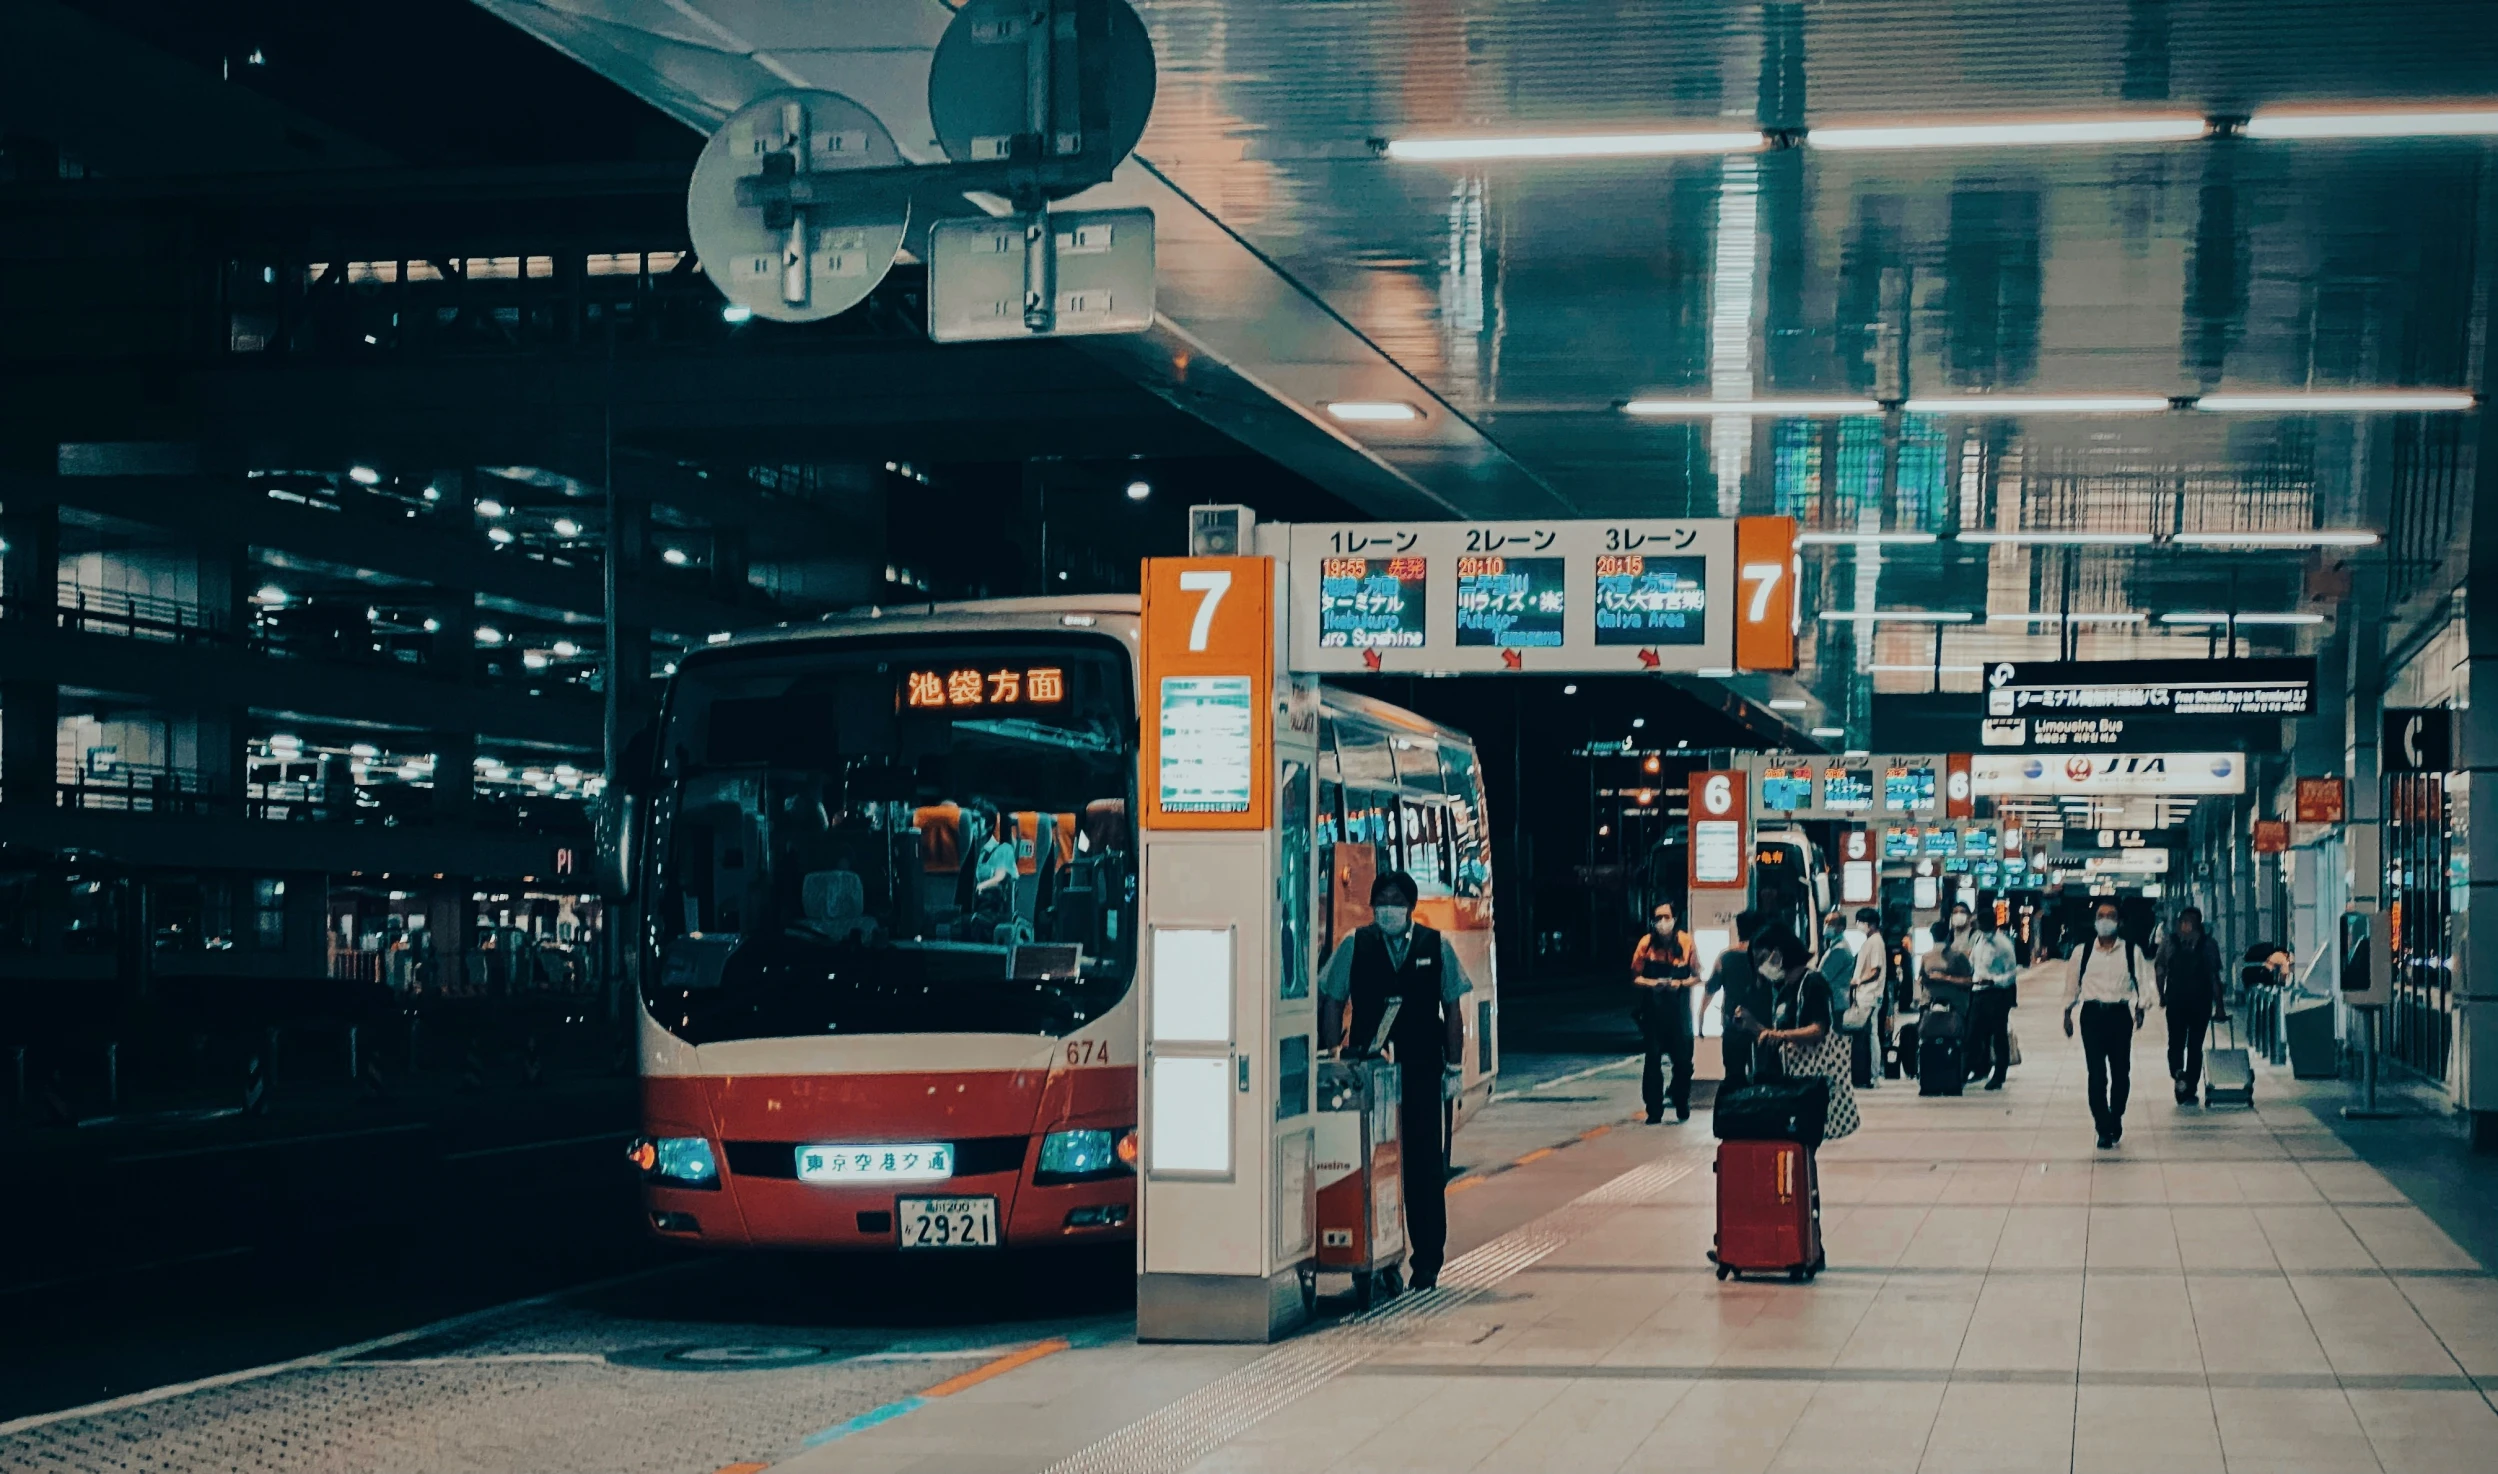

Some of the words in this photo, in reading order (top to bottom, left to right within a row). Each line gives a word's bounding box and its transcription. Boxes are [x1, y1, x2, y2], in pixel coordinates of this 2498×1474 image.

[1330, 530, 1418, 553] 1レーン
[1466, 529, 1556, 552] 2レーン
[1606, 528, 1697, 550] 3レーン
[1323, 558, 1366, 578] 19:55
[1458, 557, 1503, 577] 20:10
[1597, 555, 1643, 577] 20:15
[1743, 564, 1782, 621] 7
[1179, 570, 1232, 652] 7
[908, 667, 1062, 706] 池袋方面
[2035, 719, 2096, 733] Limousine
[2099, 718, 2124, 733] Bus
[2099, 757, 2167, 775] JTA
[1704, 774, 1732, 815] 6
[1948, 771, 1970, 800] 6
[1849, 831, 1867, 859] 5
[1066, 1040, 1109, 1065] 674
[804, 1151, 947, 1173] 東京空港交通
[916, 1214, 988, 1244] 29-21
